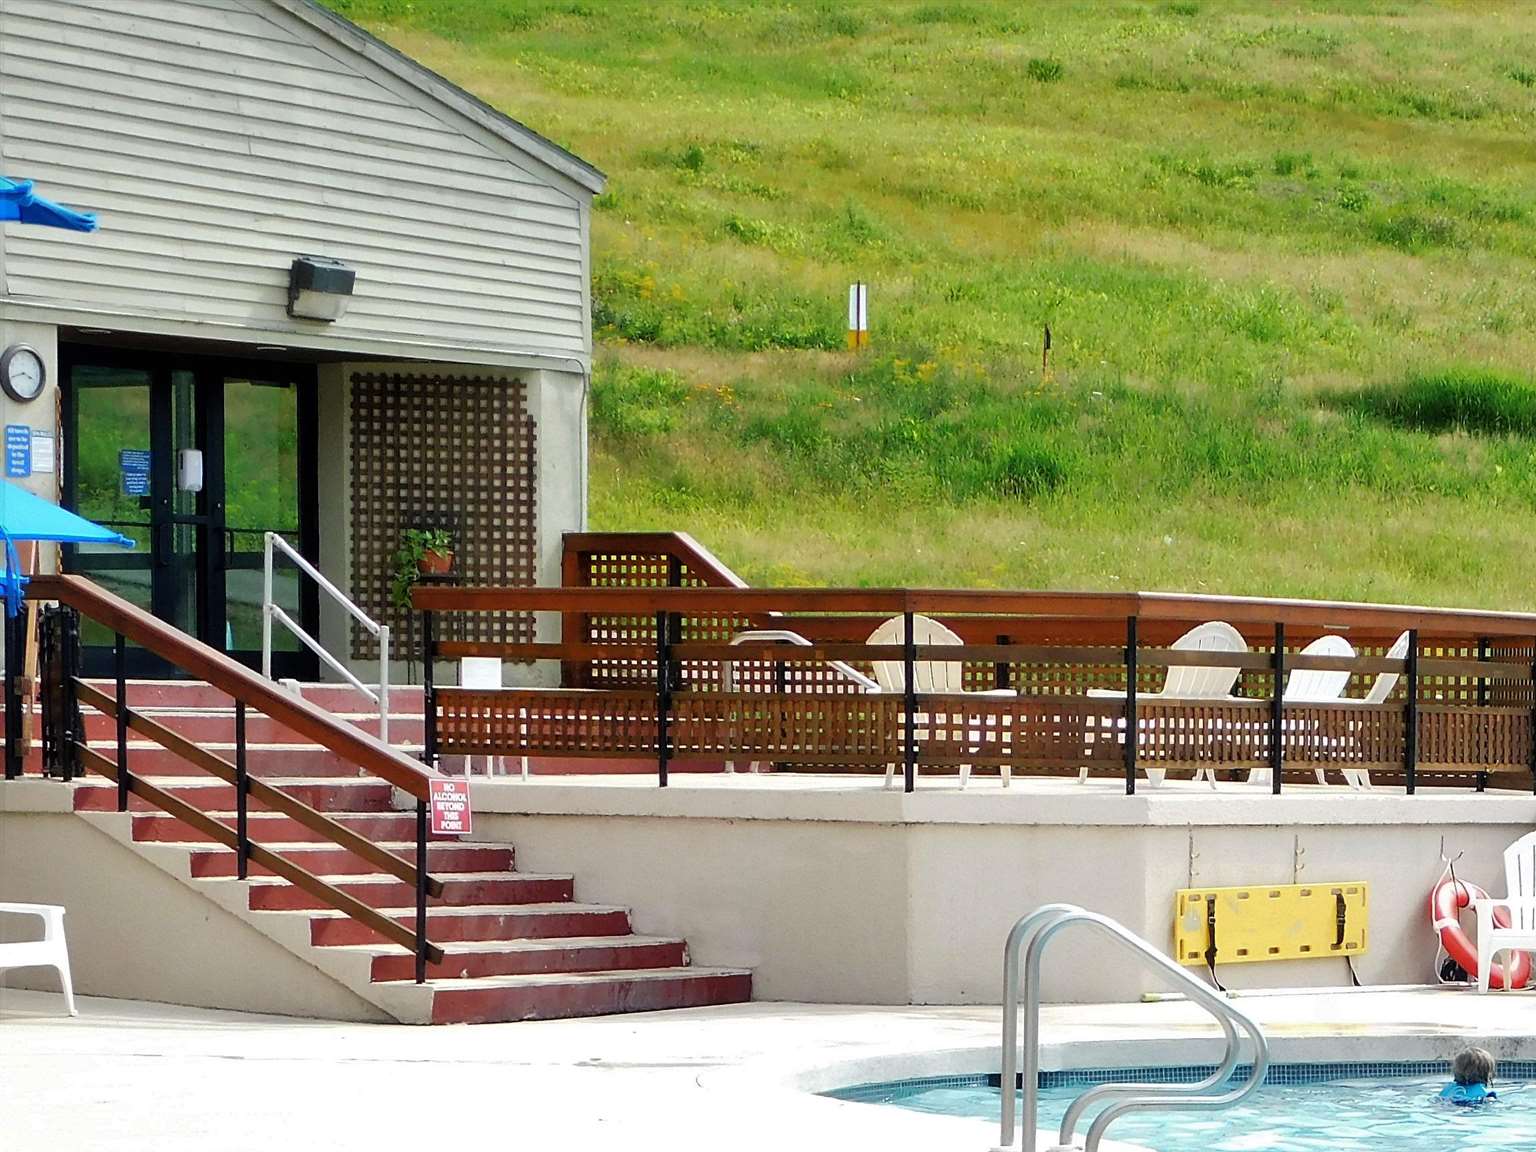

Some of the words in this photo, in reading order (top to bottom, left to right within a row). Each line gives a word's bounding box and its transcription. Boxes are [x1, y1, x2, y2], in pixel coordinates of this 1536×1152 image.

[443, 783, 455, 792] NO
[433, 792, 467, 801] ALCOHOL
[436, 801, 465, 811] BEYOND
